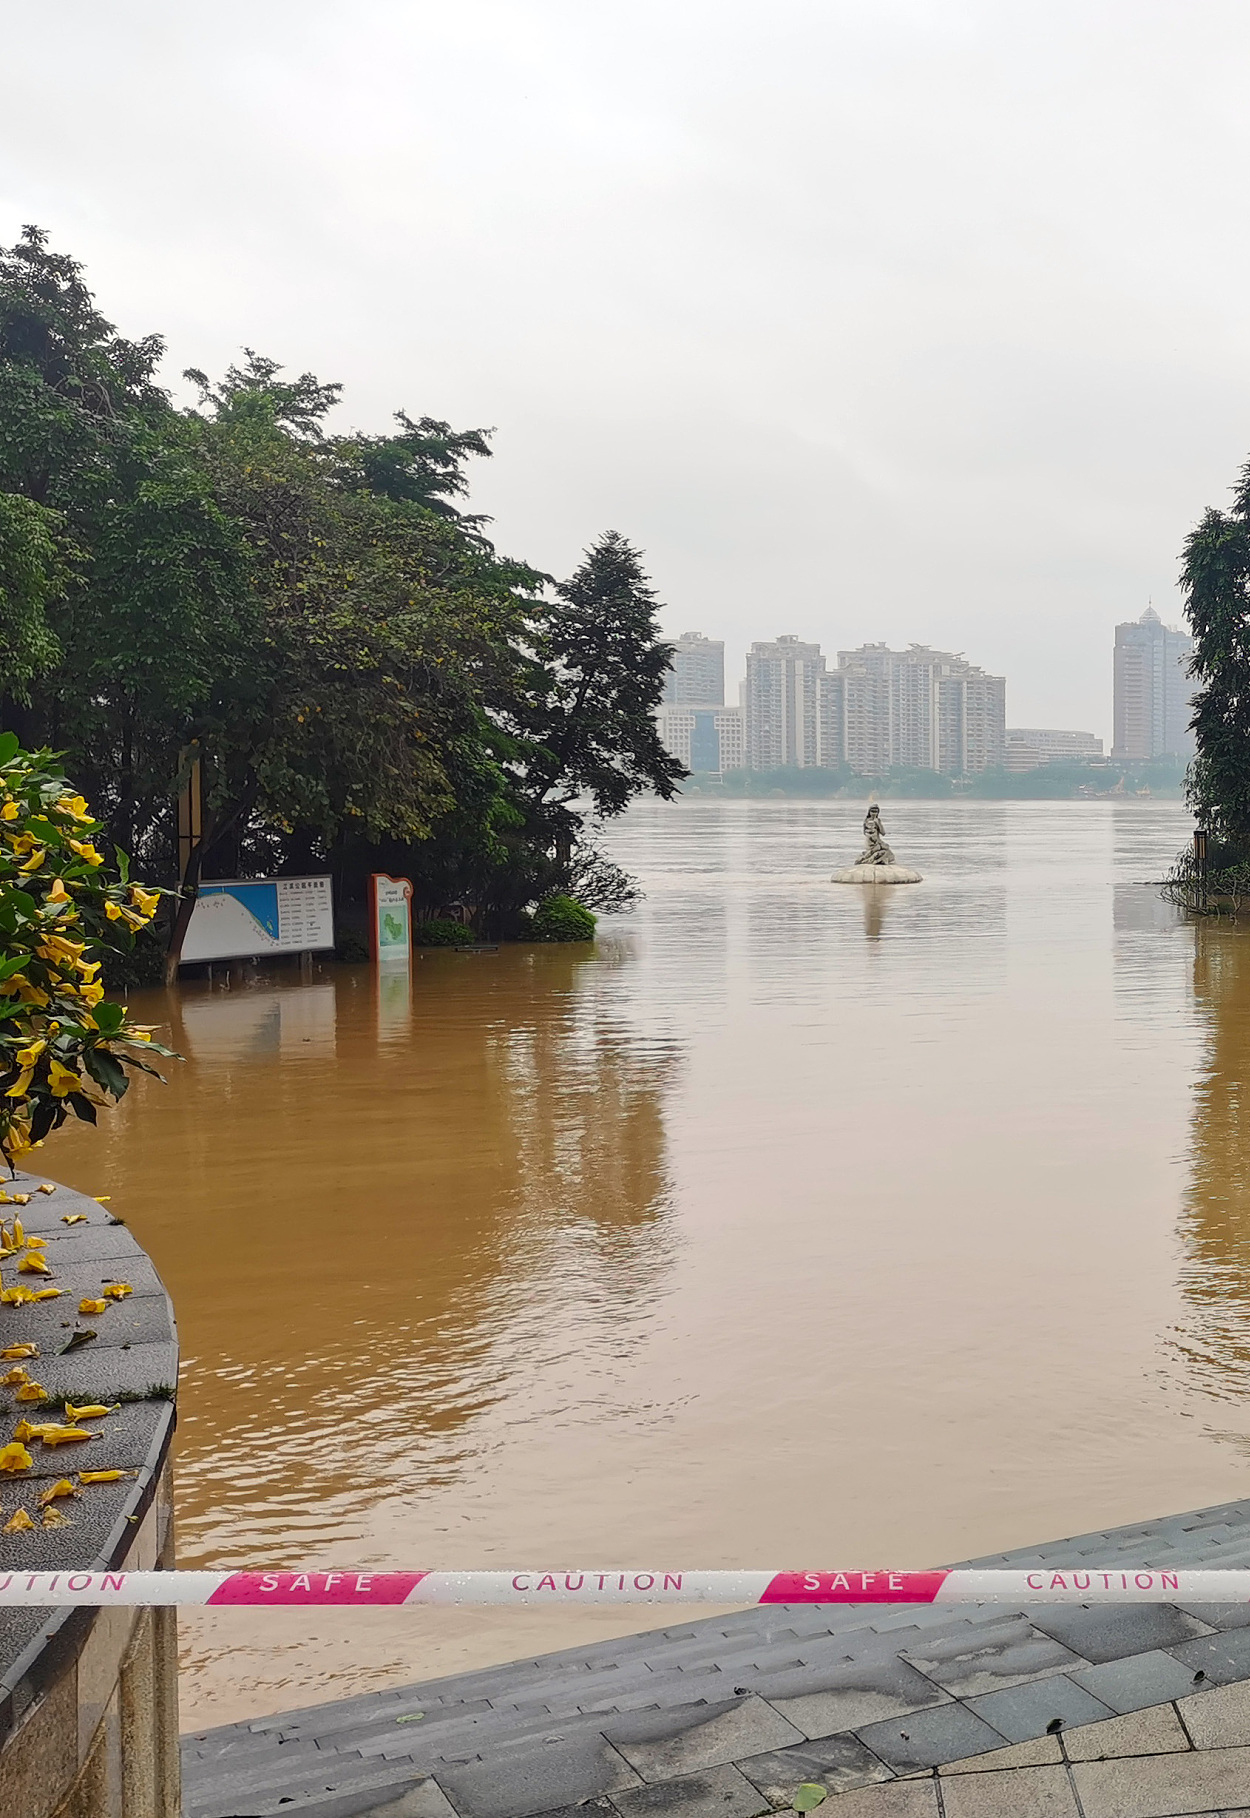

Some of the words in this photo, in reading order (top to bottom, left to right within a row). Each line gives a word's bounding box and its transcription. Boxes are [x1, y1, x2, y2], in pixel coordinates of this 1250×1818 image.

[258, 1573, 375, 1592] SAFE
[511, 1574, 684, 1591] CAUTION
[803, 1573, 904, 1591] SAFE
[1026, 1573, 1180, 1590] CAUTION
